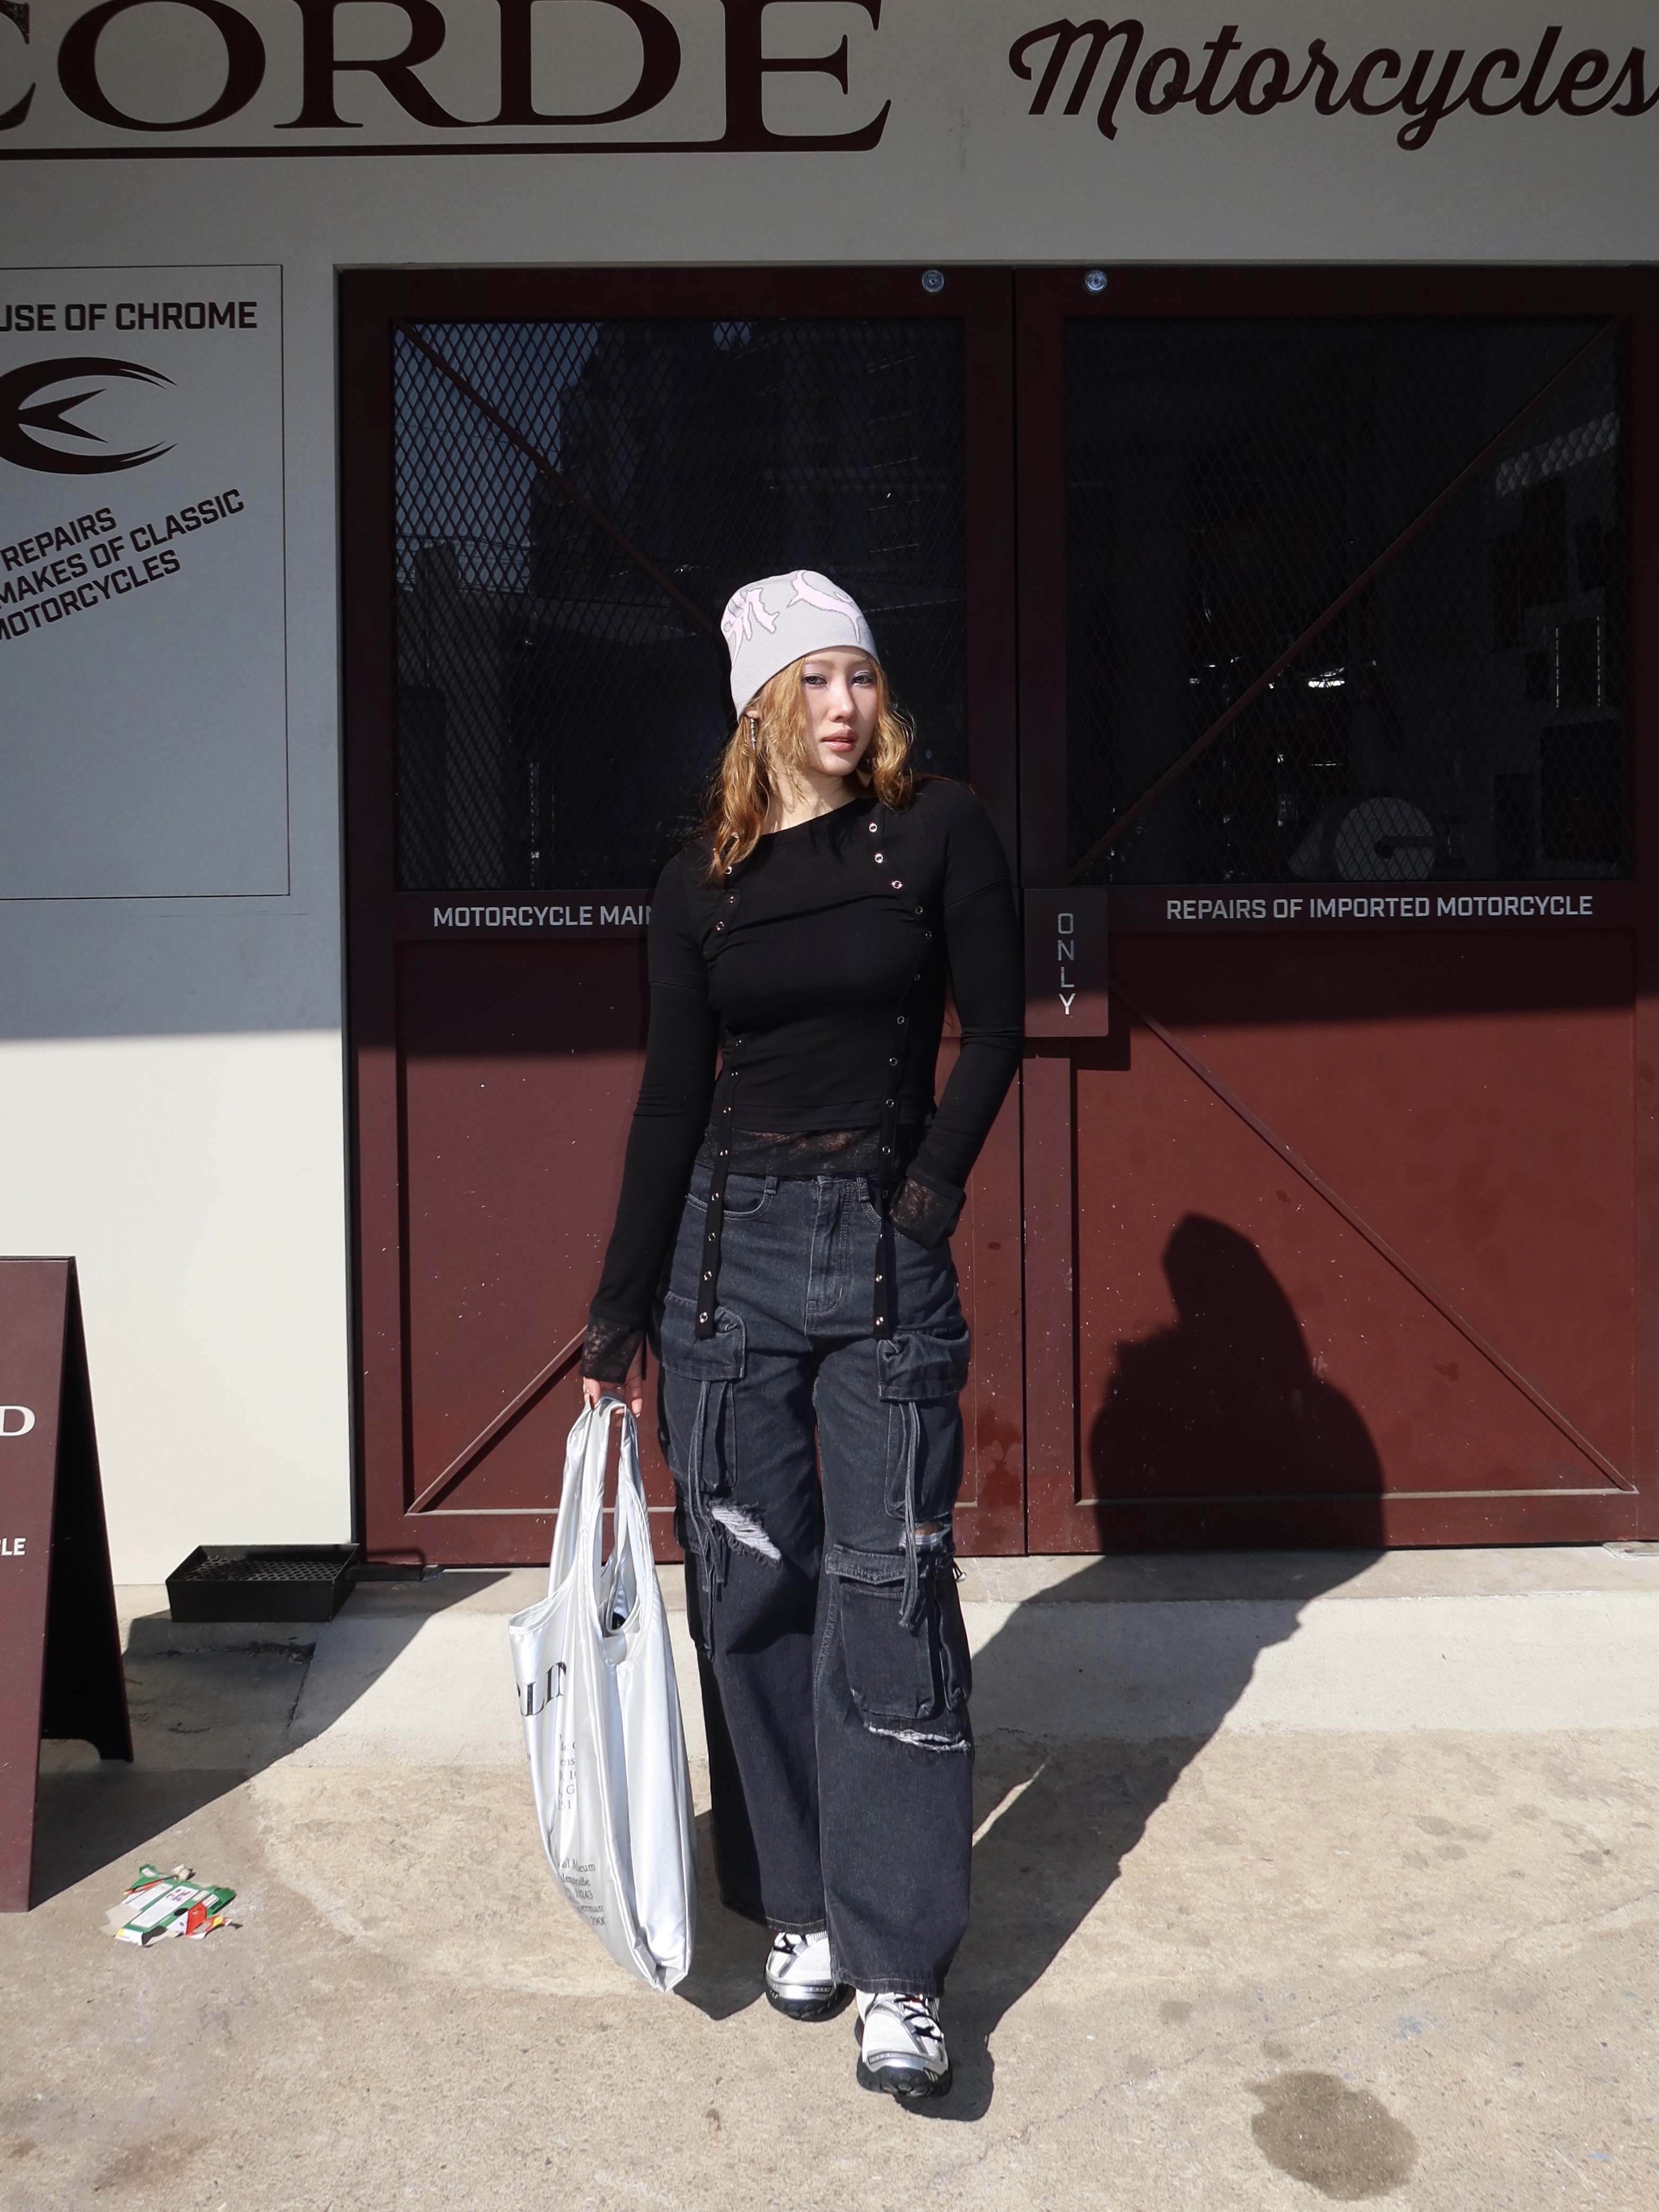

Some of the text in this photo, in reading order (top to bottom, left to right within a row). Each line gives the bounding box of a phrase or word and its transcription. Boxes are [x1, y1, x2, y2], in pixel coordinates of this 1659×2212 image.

[0, 0, 892, 153] ORDE
[1008, 18, 1659, 151] Motorcycles
[65, 303, 107, 331] OF
[116, 302, 257, 330] CHROME
[0, 507, 117, 572] REPAIRS
[0, 489, 244, 604] MAKES OF CLASSIC
[434, 906, 593, 927] MOTORCYCLE
[1167, 896, 1593, 919] REPAIRS OF IMPORTED MOTORCYCLE
[1058, 913, 1076, 1015] ONLY
[0, 1537, 27, 1556] LE
